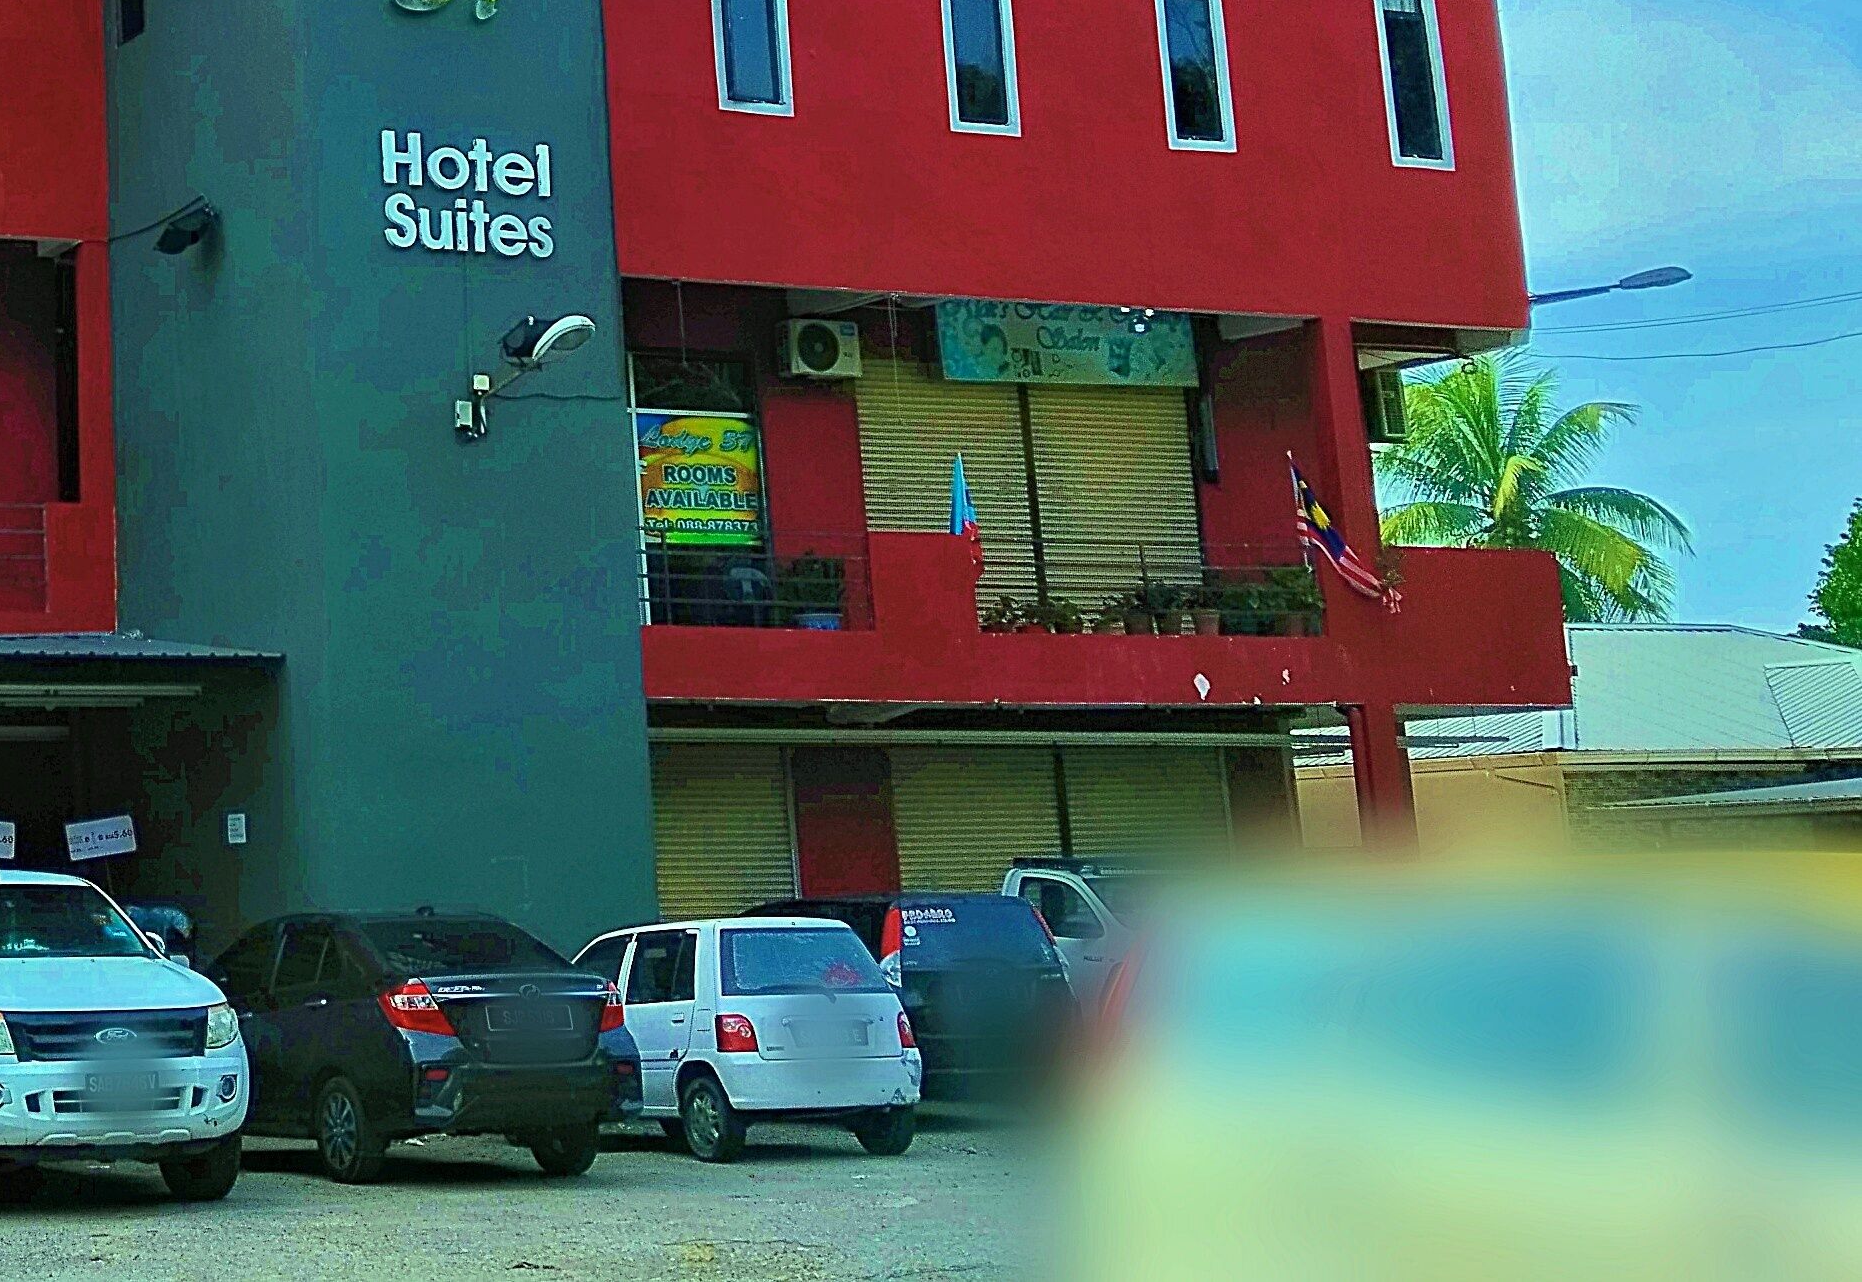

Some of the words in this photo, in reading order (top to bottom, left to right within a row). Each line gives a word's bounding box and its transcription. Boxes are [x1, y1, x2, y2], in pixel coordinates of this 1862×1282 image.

[381, 129, 551, 197] Hotel
[383, 193, 554, 258] Suites
[639, 424, 713, 456] Lodge
[719, 429, 755, 451] 37
[662, 463, 738, 485] ROOMS
[644, 488, 759, 510] AVAILABLE
